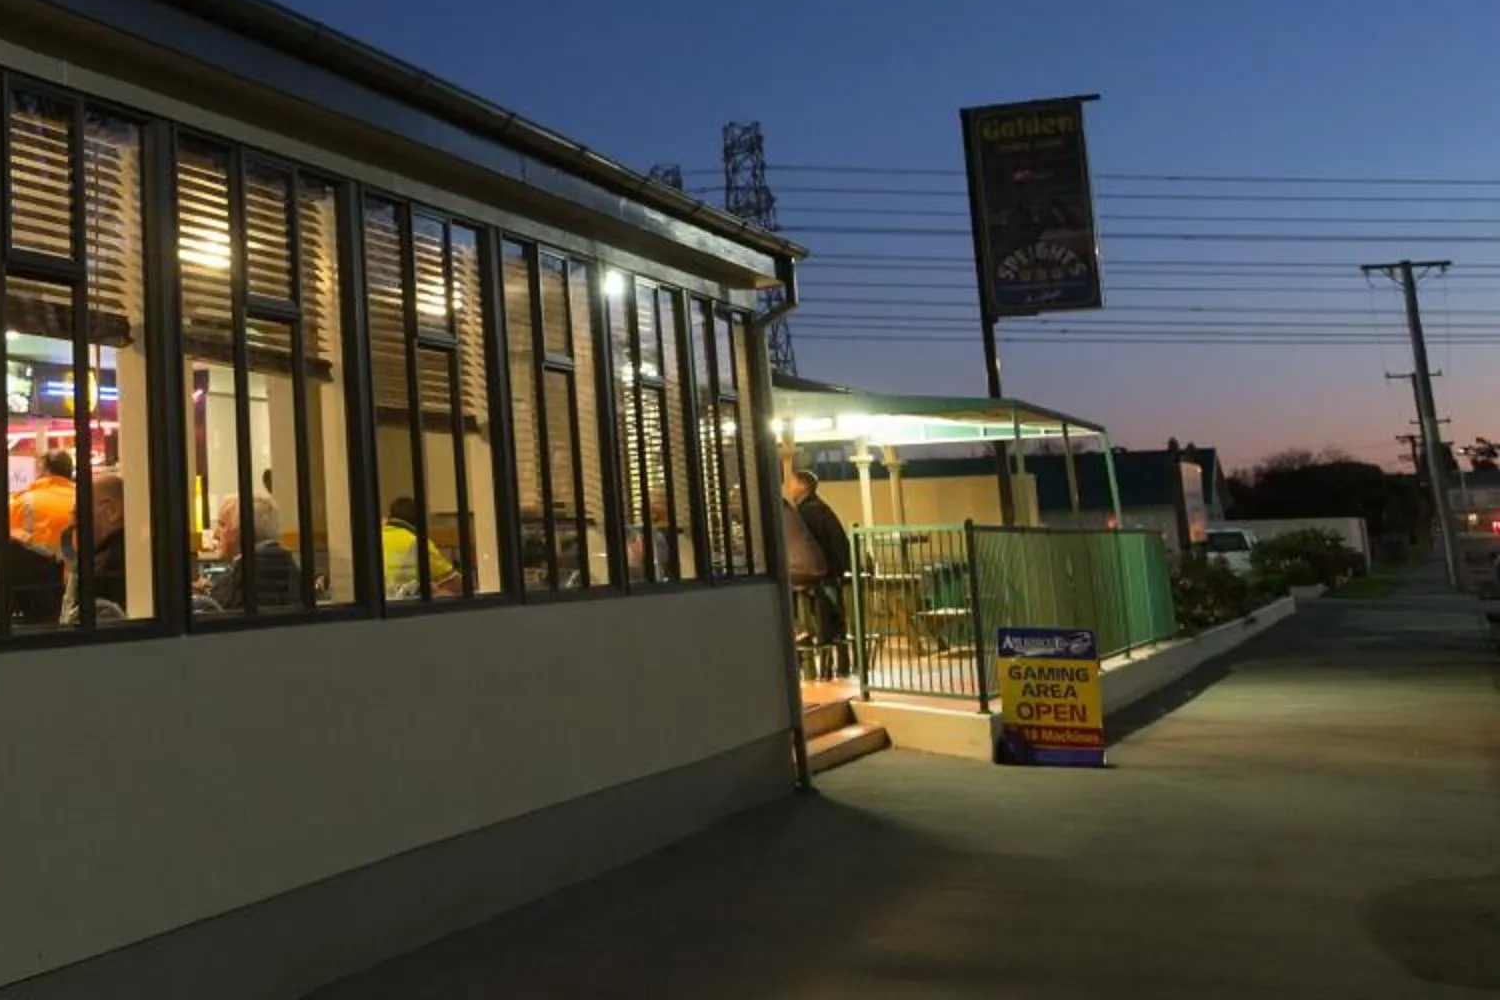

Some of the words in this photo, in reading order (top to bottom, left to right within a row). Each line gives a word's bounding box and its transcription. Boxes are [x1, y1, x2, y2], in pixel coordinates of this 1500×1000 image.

[1007, 665, 1089, 683] GAMING
[1022, 683, 1078, 699] AREA
[1016, 702, 1088, 723] OPEN
